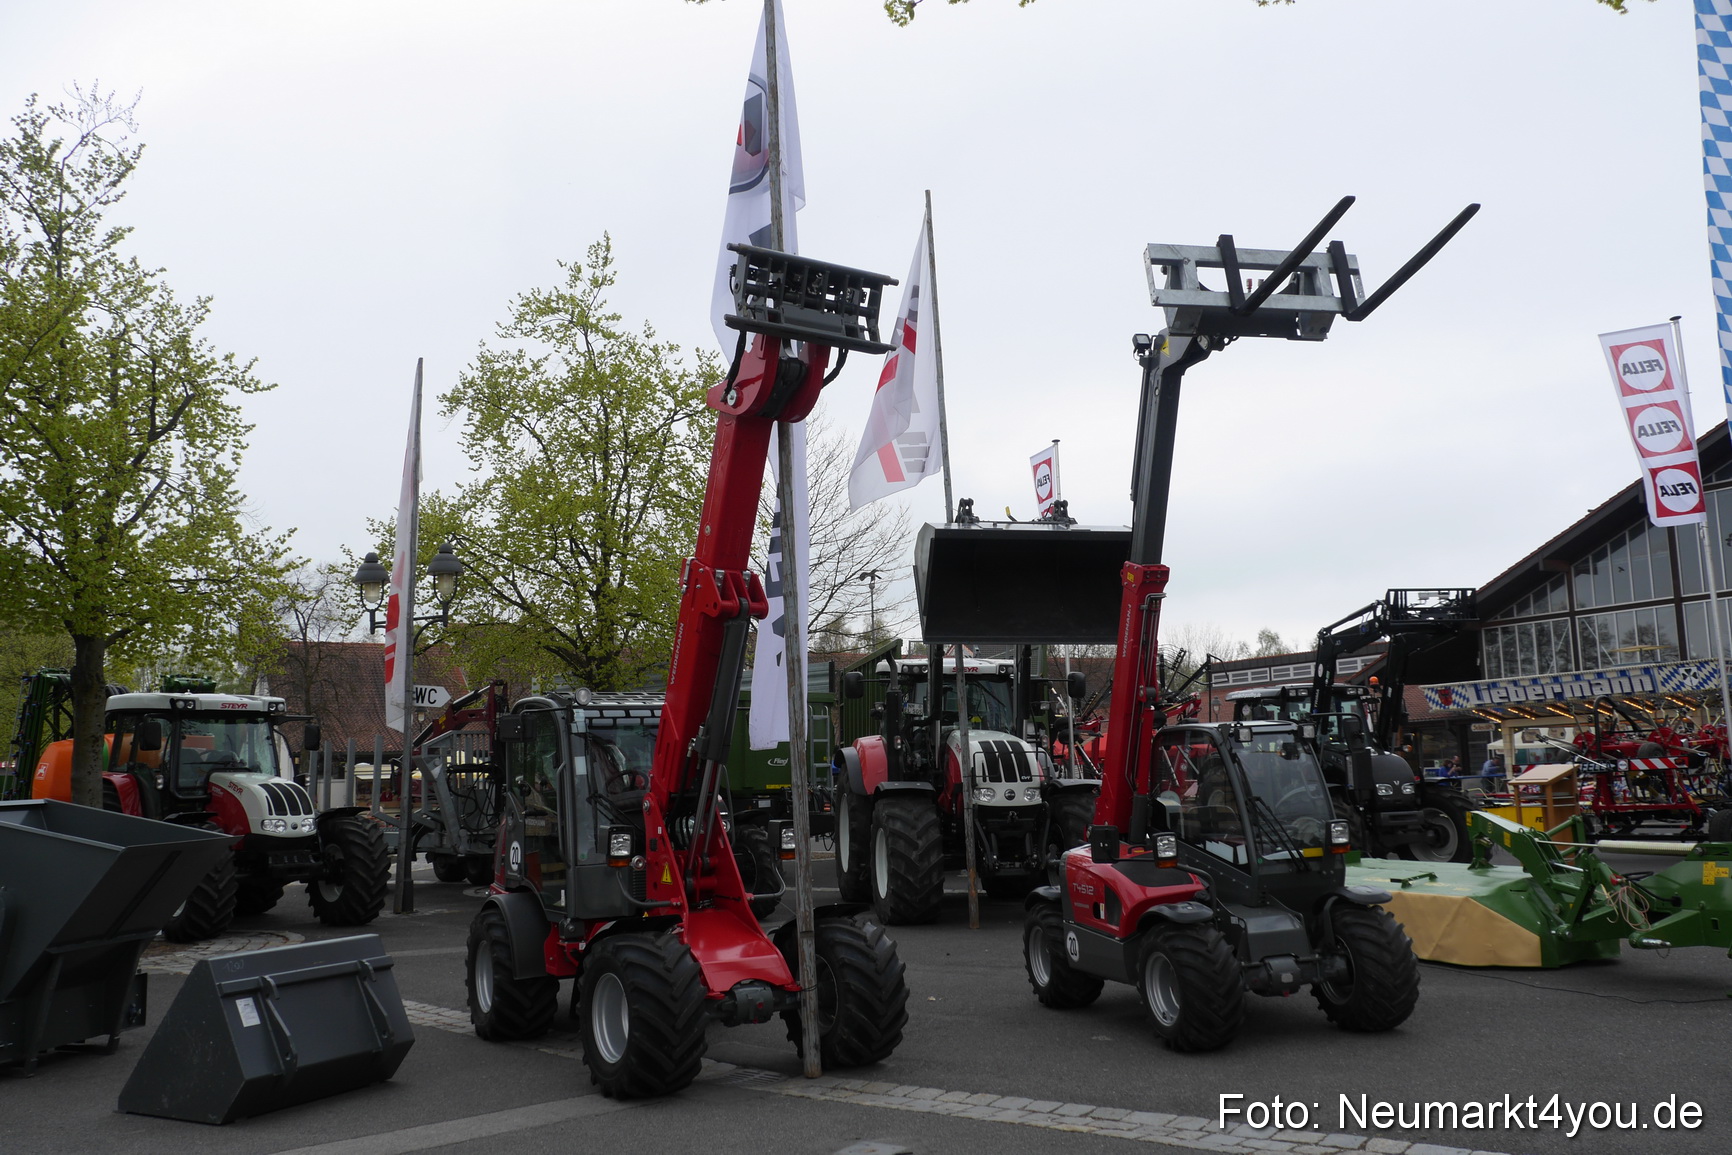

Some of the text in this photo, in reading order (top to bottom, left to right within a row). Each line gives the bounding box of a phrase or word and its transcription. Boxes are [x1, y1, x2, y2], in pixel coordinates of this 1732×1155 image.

[670, 622, 684, 685] WEIDEMANN
[415, 687, 438, 705] WC
[1466, 673, 1654, 706] Liebermann
[227, 781, 244, 796] STEYR
[511, 846, 519, 865] 20
[1072, 882, 1094, 896] T4512
[1069, 936, 1078, 957] 20
